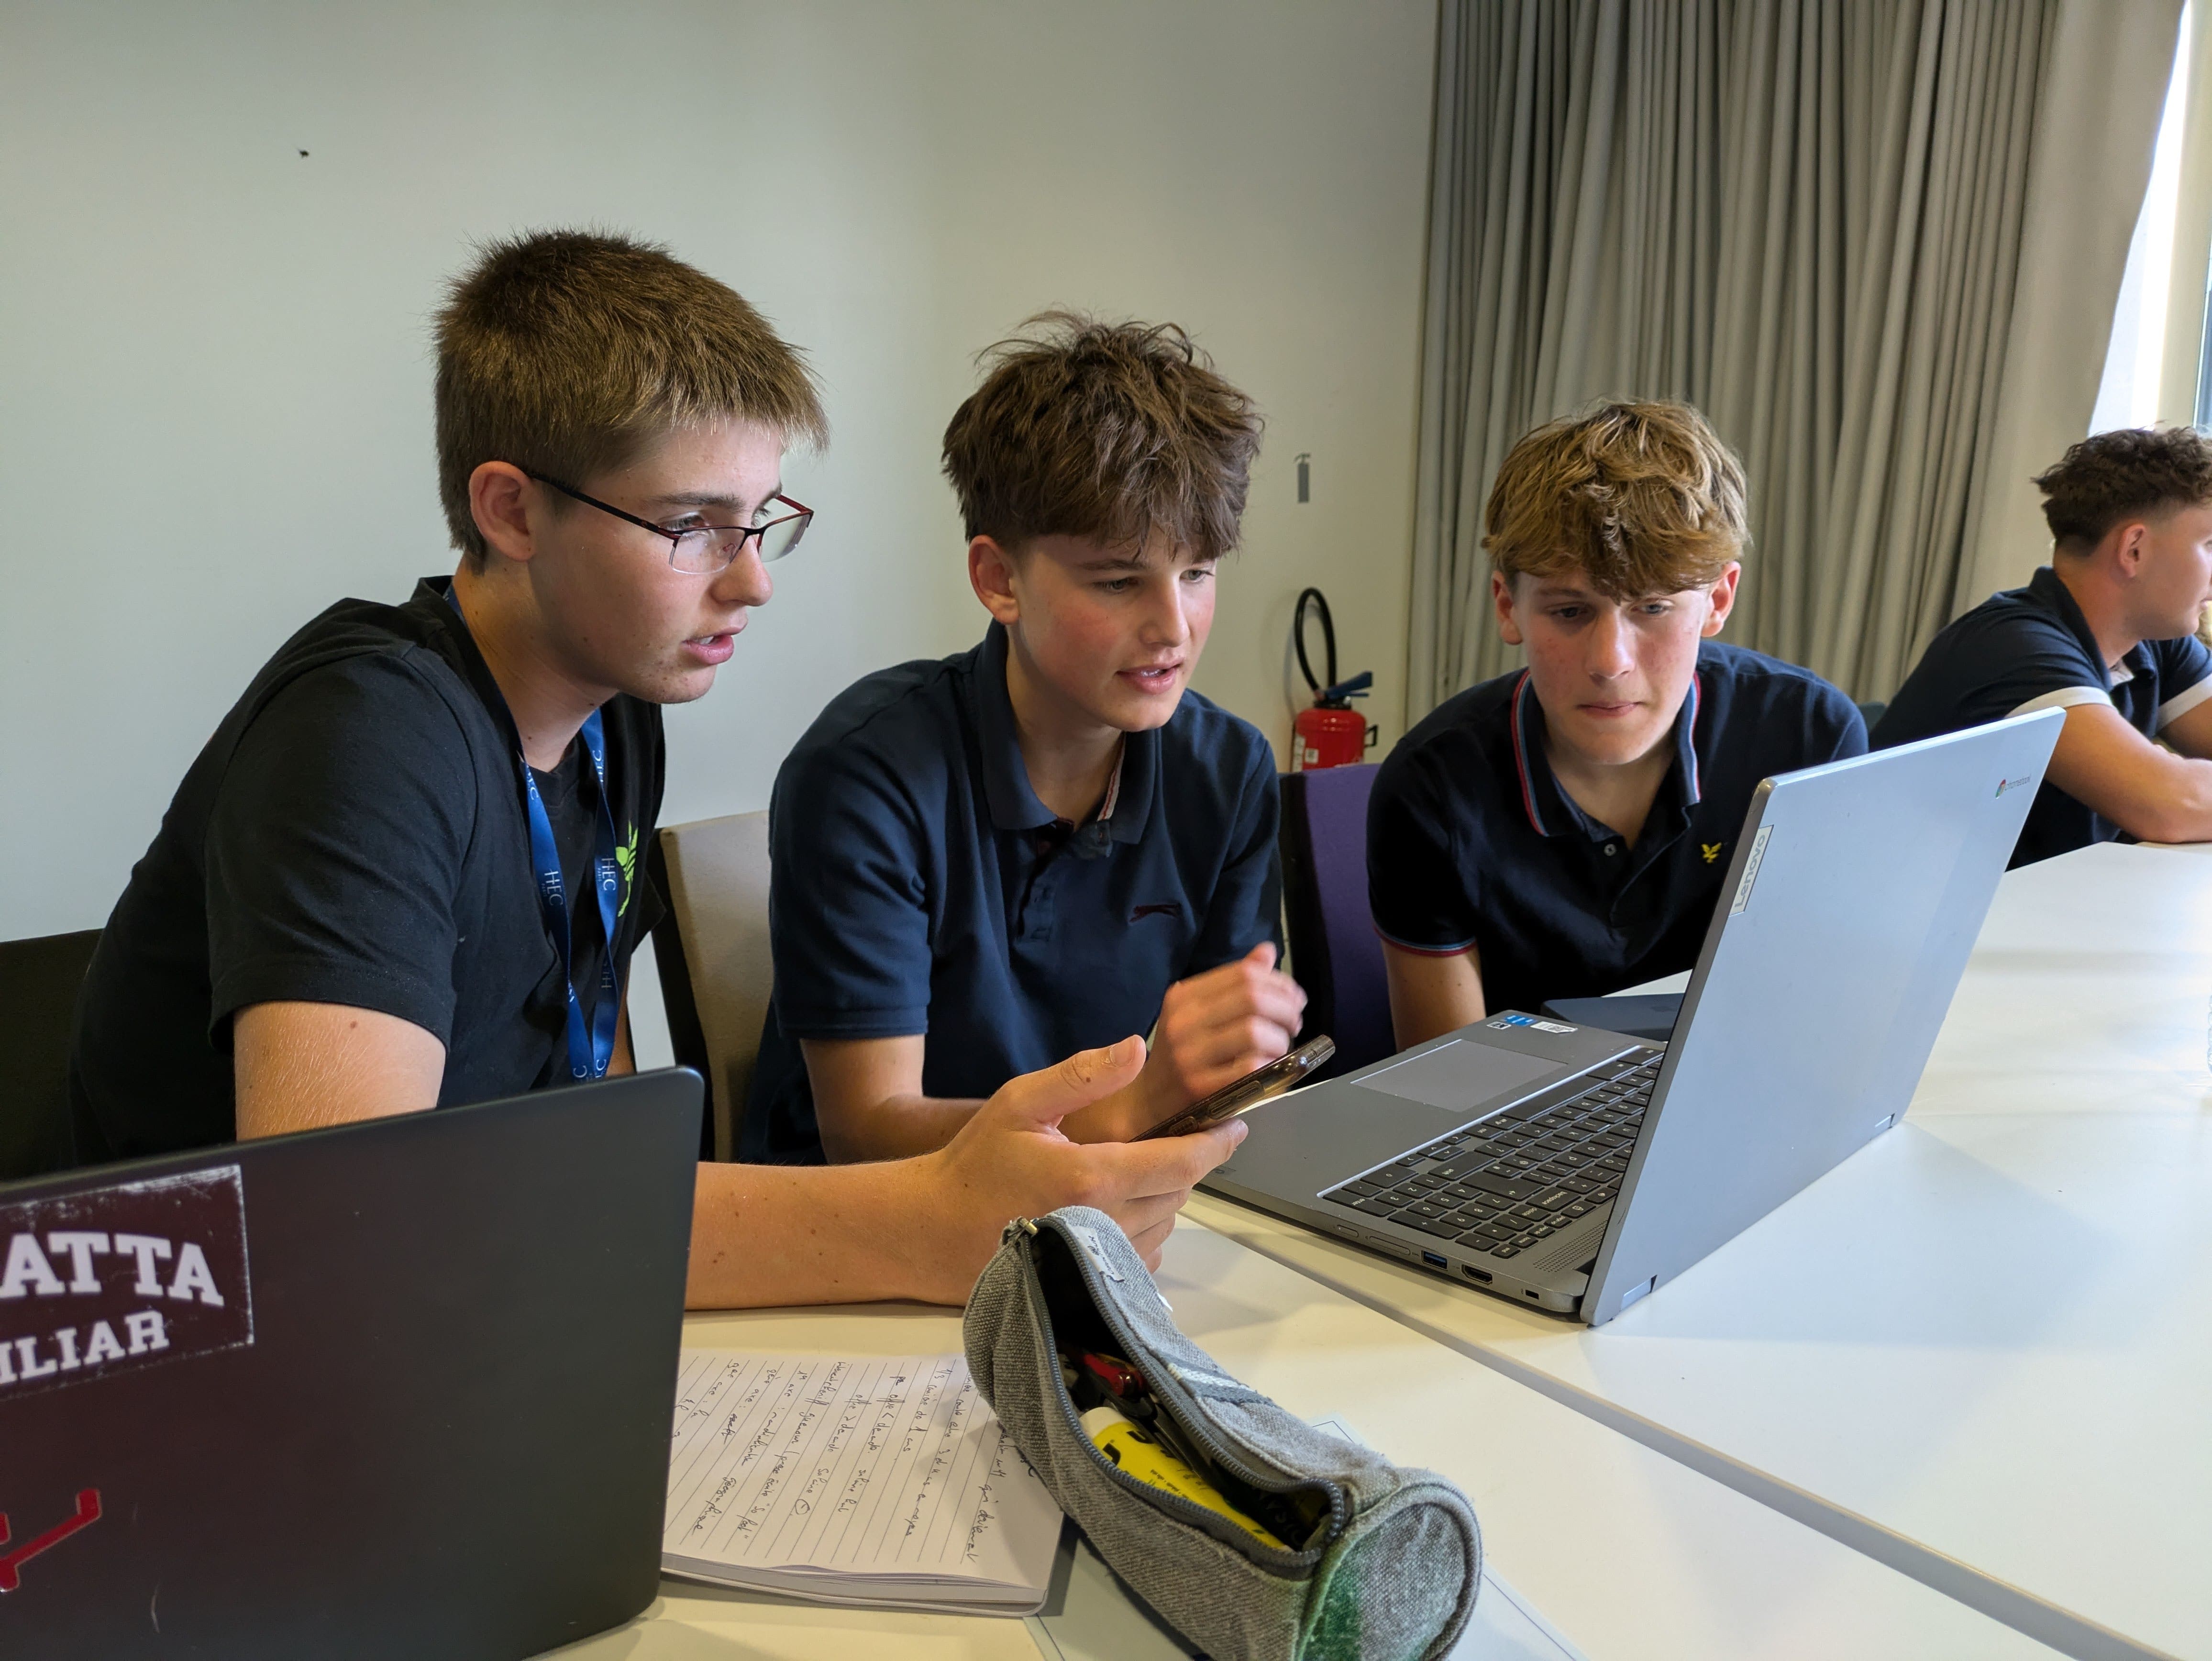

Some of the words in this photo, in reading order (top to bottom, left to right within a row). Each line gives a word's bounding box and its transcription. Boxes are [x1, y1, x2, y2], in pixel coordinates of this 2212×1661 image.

[544, 868, 564, 906] HEC
[601, 858, 616, 891] HEC
[1735, 834, 1765, 908] Lenovo
[0, 1231, 225, 1307] ATTA
